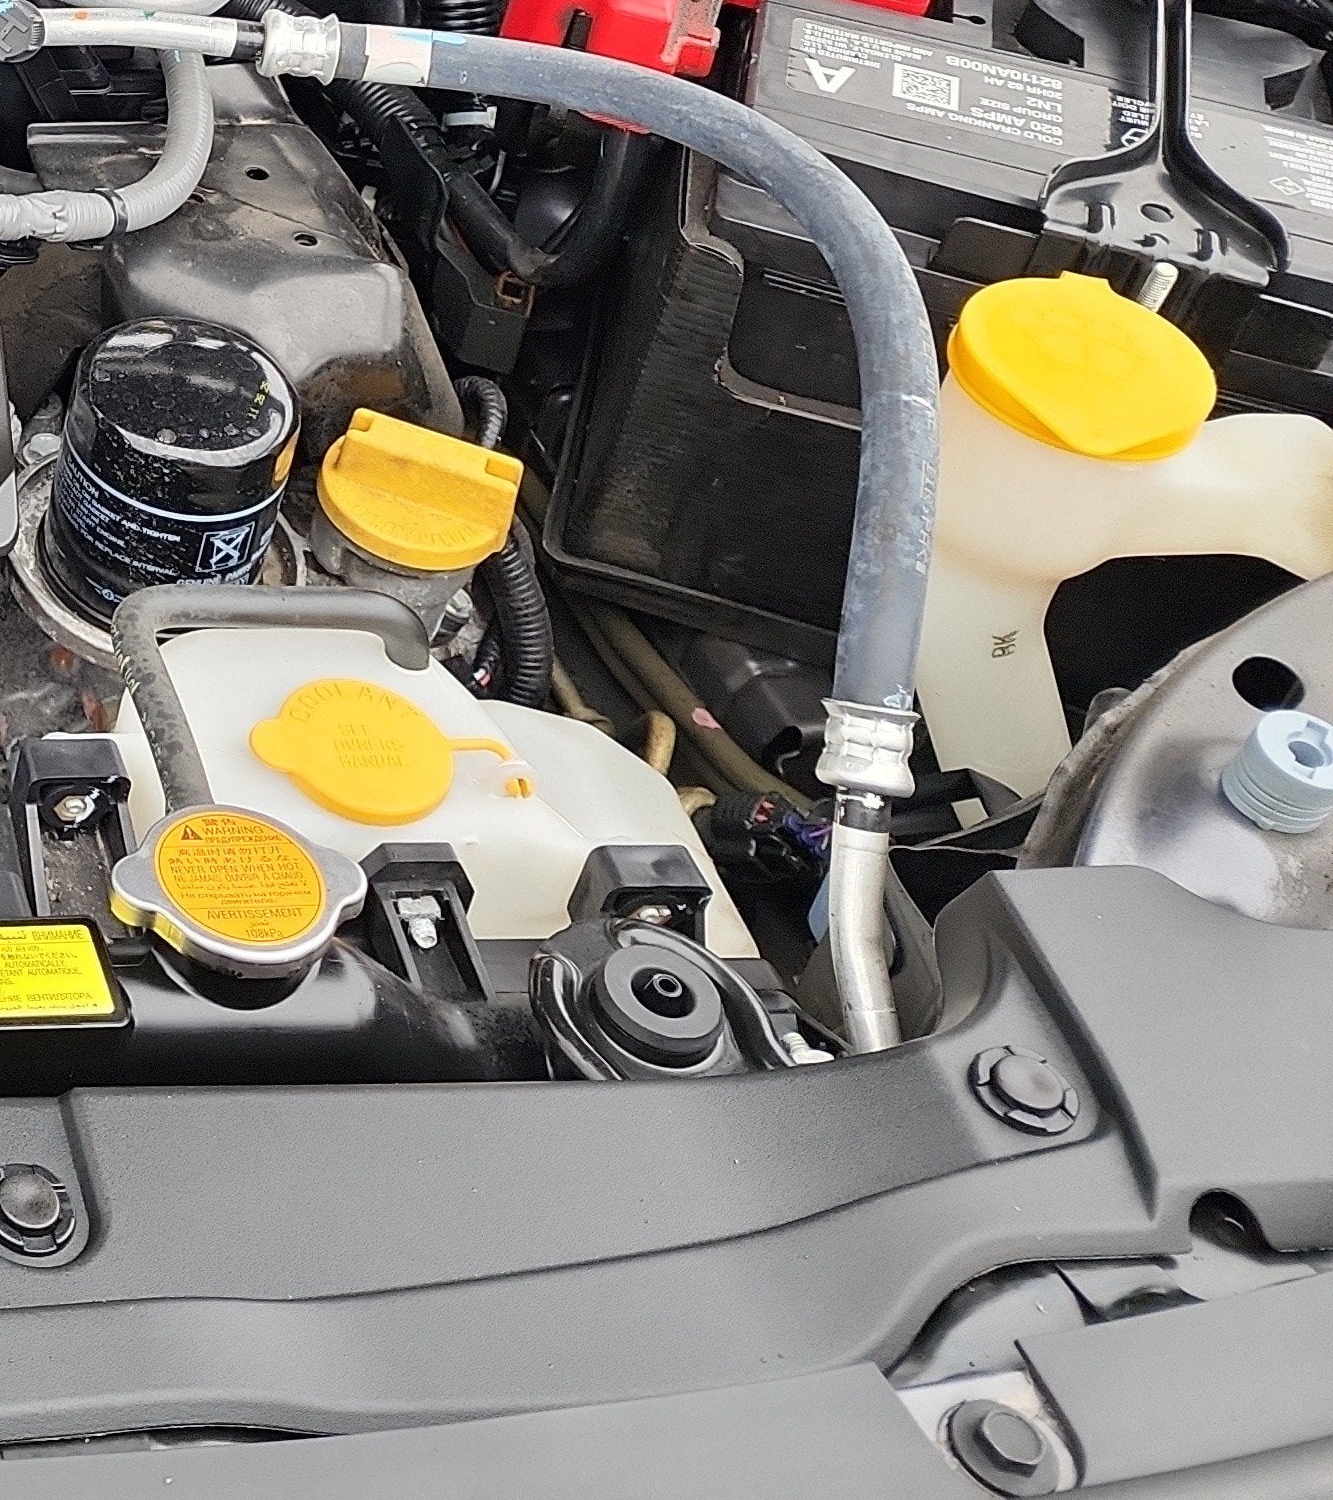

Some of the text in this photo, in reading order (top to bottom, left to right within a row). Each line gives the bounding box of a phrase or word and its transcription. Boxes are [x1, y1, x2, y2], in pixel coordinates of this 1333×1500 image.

[806, 23, 933, 57] AND IMPORTED MATERIALS
[818, 50, 881, 69] DISTRIBUTED
[893, 50, 922, 61] MADE
[804, 58, 856, 93] A
[945, 55, 1063, 90] 82110AN00B
[984, 76, 1063, 99] 20HR 62 AH
[979, 97, 1063, 123] GROUP SIZE
[1026, 97, 1063, 113] LN2
[906, 102, 1063, 146] COLD CRANKING AMPS
[970, 106, 1063, 136] 620 AMPS
[290, 683, 419, 723] COOLANT
[202, 825, 264, 835] WARNING
[170, 861, 304, 874] NEVER OPEN WHEN HOT.
[207, 907, 303, 920] AVERTISSEMENT
[32, 929, 84, 941] ВНИМАНИЕ
[245, 928, 283, 939] 108kPa
